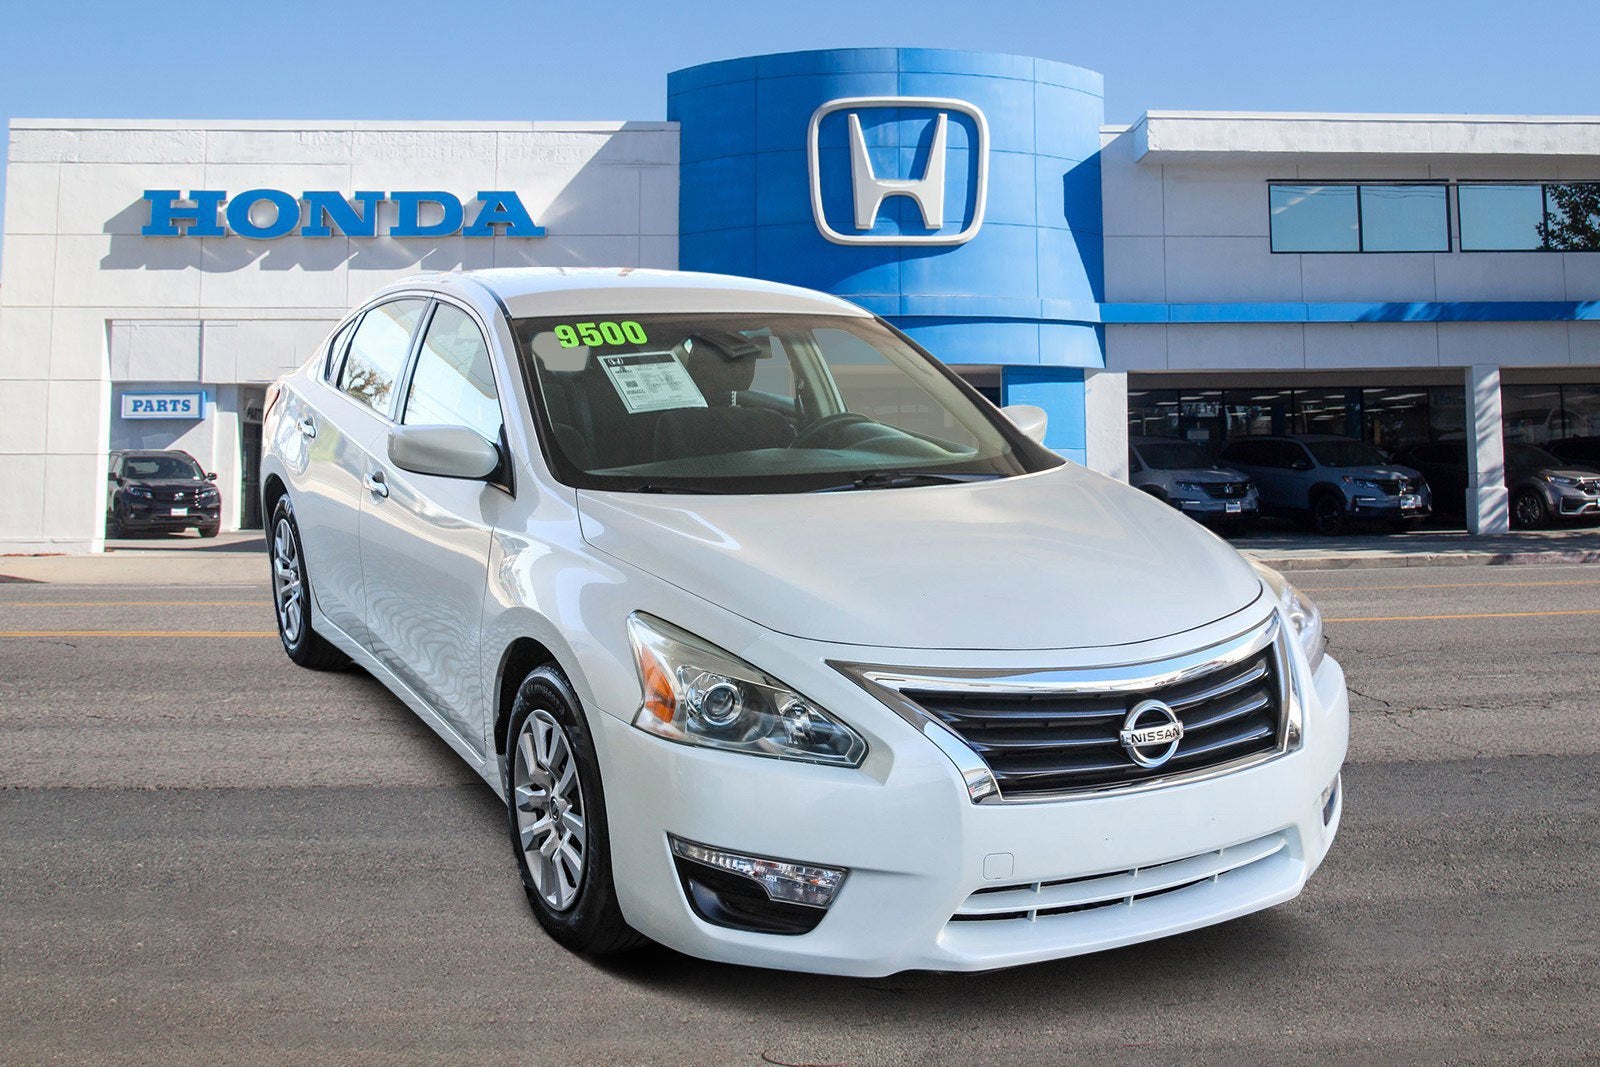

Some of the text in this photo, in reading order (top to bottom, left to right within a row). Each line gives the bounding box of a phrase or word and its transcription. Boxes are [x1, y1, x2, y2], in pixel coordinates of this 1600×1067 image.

[142, 188, 546, 239] HONDA
[554, 320, 648, 348] 9500
[131, 399, 191, 412] PARTS
[1131, 725, 1181, 744] NISSAN
